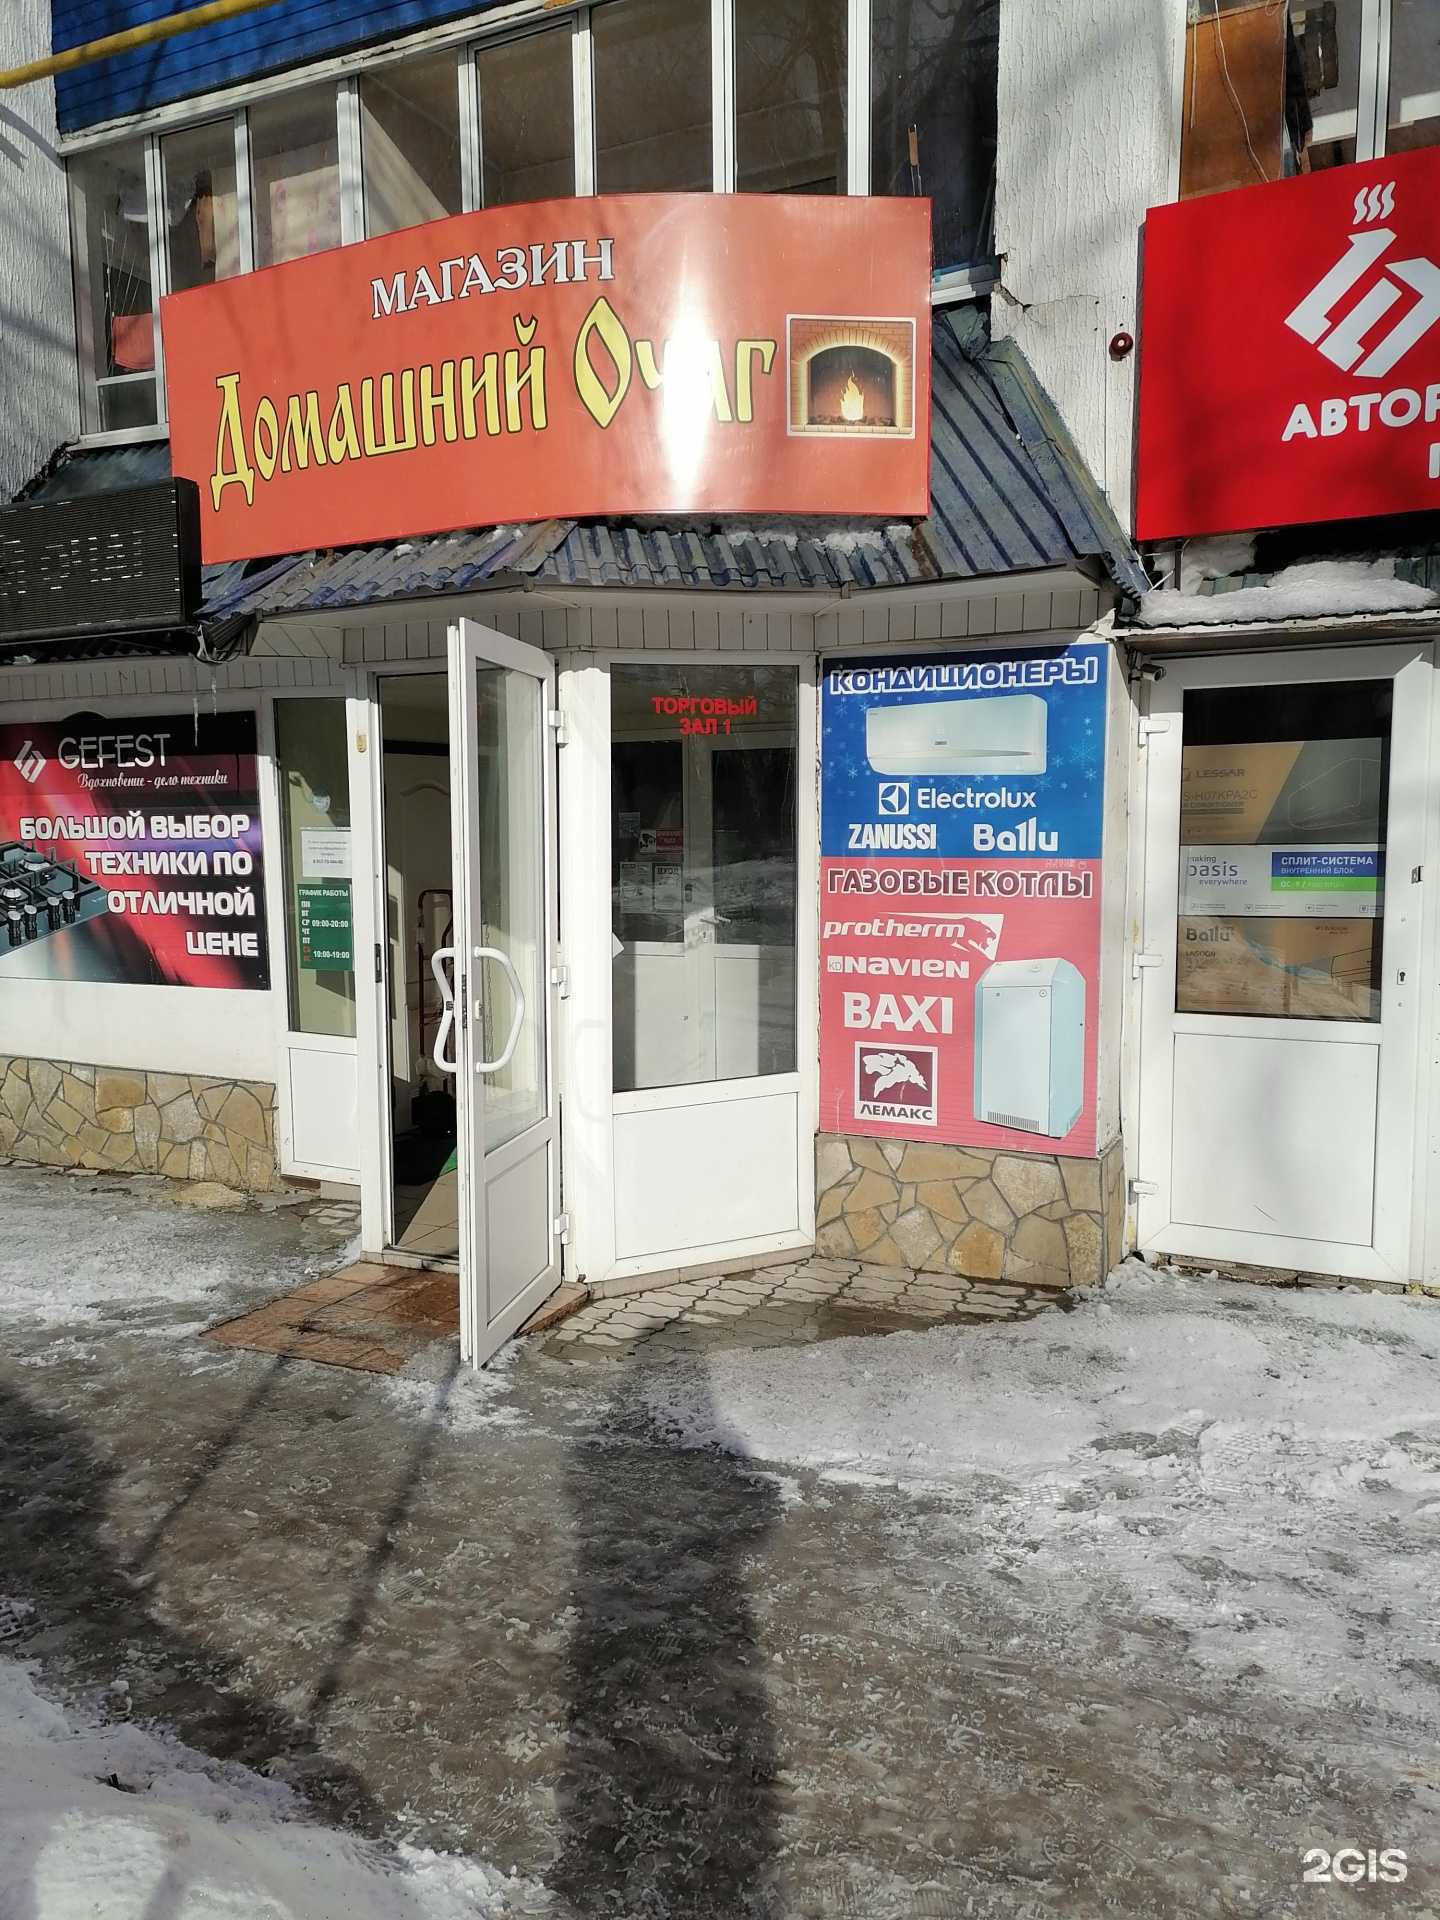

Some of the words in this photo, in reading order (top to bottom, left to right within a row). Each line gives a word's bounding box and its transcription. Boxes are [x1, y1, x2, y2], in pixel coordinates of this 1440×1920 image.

[371, 238, 615, 319] МАГАЗИН
[211, 314, 548, 511] Домашний
[830, 657, 1098, 695] КОНДИЦИОНЕРЫ
[652, 695, 757, 716] ТОРГОВЫЙ
[680, 718, 718, 736] ЗАЛ
[723, 719, 731, 736] 1
[57, 733, 171, 769] GEFEST
[78, 772, 145, 790] Вдохновение
[154, 776, 179, 789] дело
[181, 769, 228, 786] техники
[917, 787, 1036, 809] Electrolux
[20, 811, 145, 841] БОЛЬШОЙ
[151, 814, 250, 840] ВЫБОР
[848, 823, 937, 850] ZANUSSI
[973, 816, 1058, 852] Ballu
[85, 850, 206, 877] ТЕХНИКИ
[213, 851, 252, 876] ПО
[1281, 856, 1374, 865] СПЛИТ-СИСТЕМА
[828, 868, 969, 897] ГАЗОВЫЕ
[975, 870, 1093, 899] КОТЛЫ
[107, 886, 256, 917] ОТЛИЧНОЙ
[823, 918, 965, 939] protherm
[186, 932, 259, 957] ЦЕНЕ
[842, 991, 953, 1035] BAXI
[860, 1104, 933, 1121] ЛЕМАКС
